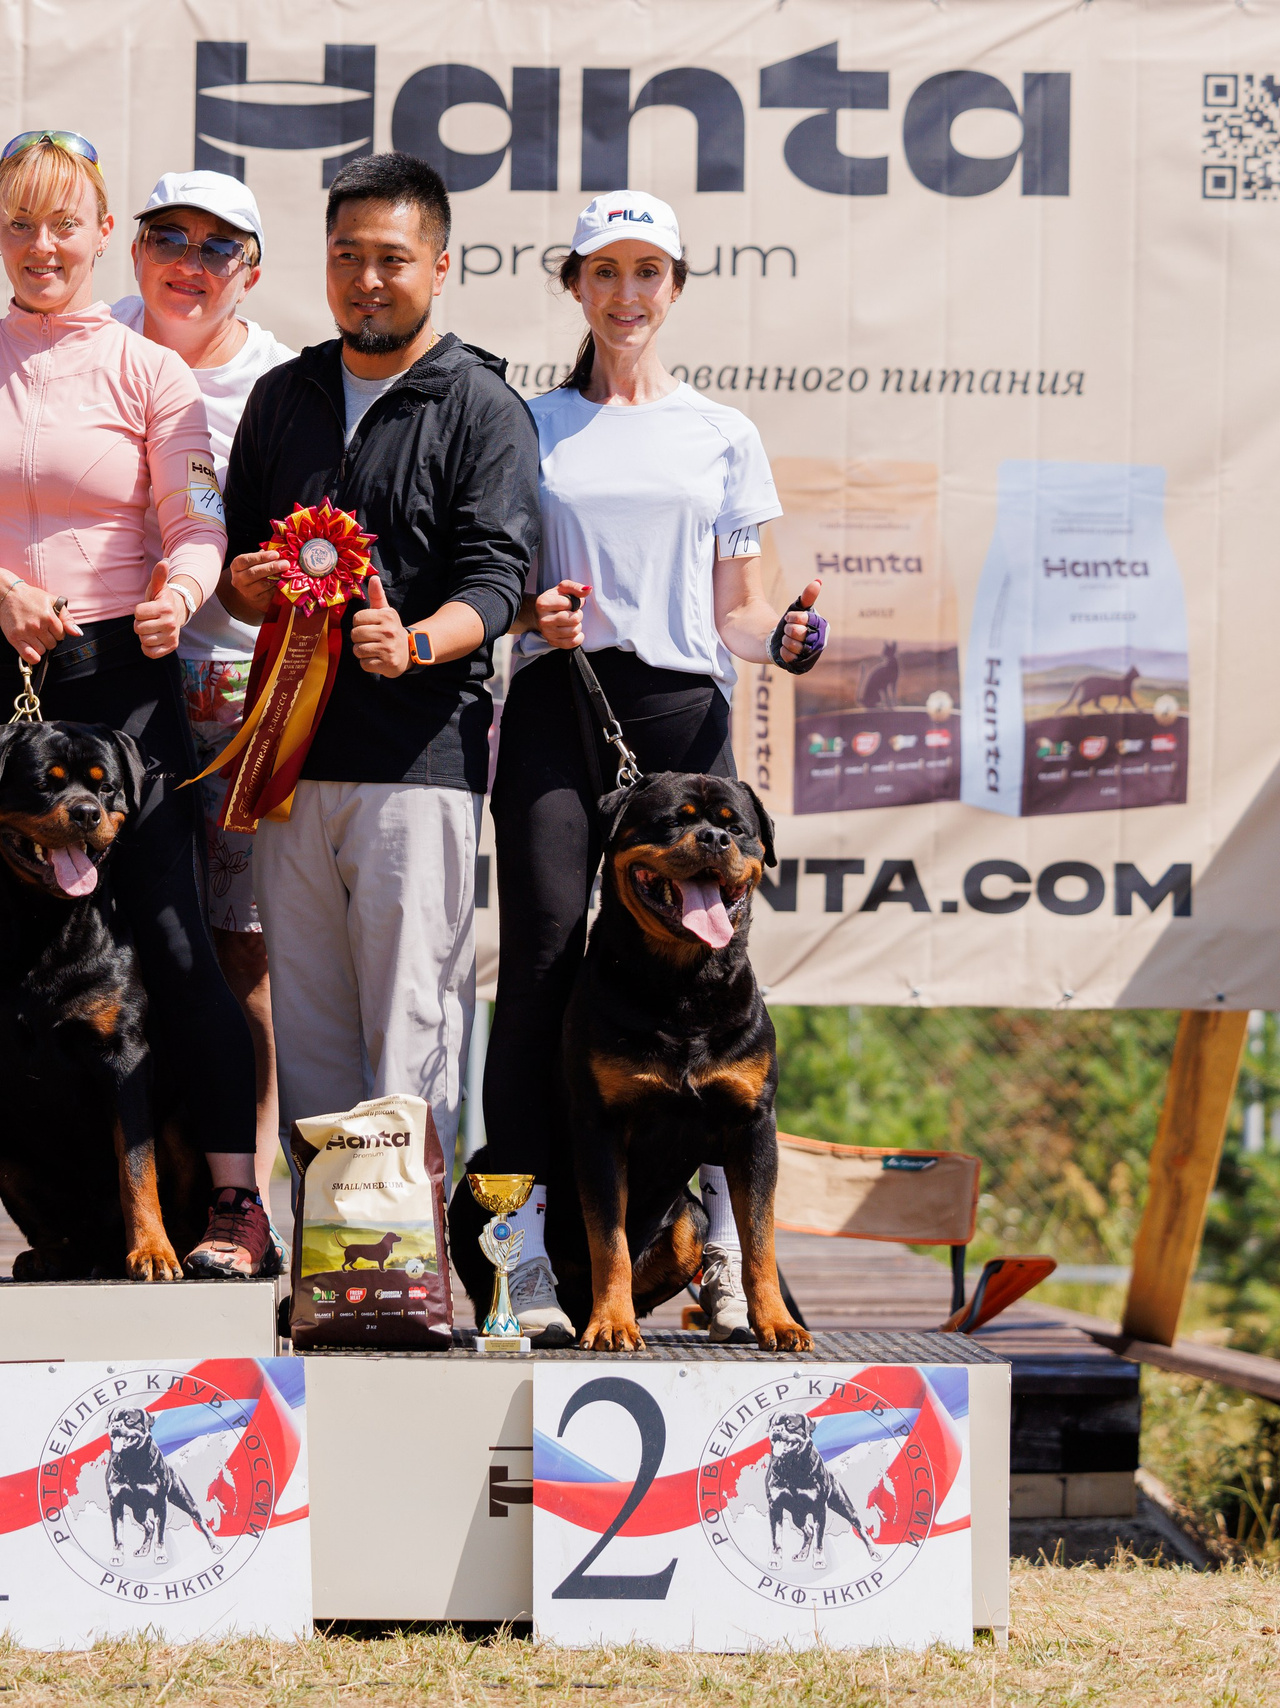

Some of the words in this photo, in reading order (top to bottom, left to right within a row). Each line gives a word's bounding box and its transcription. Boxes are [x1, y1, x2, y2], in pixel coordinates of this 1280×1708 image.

[193, 40, 1073, 197] Hanta
[607, 209, 654, 225] FILA
[460, 242, 798, 286] preum
[880, 366, 1086, 396] питания
[815, 552, 924, 575] Hanta
[1042, 556, 1150, 579] Hanta
[268, 691, 288, 734] класса
[984, 657, 1001, 793] Hanta
[145, 772, 177, 781] EMIX
[326, 1130, 411, 1151] Hanta
[353, 1151, 384, 1159] premium
[331, 1181, 404, 1192] SMALL/MEDIUM
[41, 1378, 130, 1545] РОТВЕЙЛЕР
[146, 1375, 226, 1409] КЛУБ
[231, 1413, 271, 1541] РОССИИ
[701, 1383, 790, 1547] РОТВЕЙЛЕР
[808, 1379, 887, 1417] КЛУБ
[893, 1422, 932, 1549] РОССИИ
[551, 1376, 678, 1601] 2
[99, 1562, 227, 1601] РКФ-НКПР
[757, 1571, 885, 1607] РКФ-НКПР
